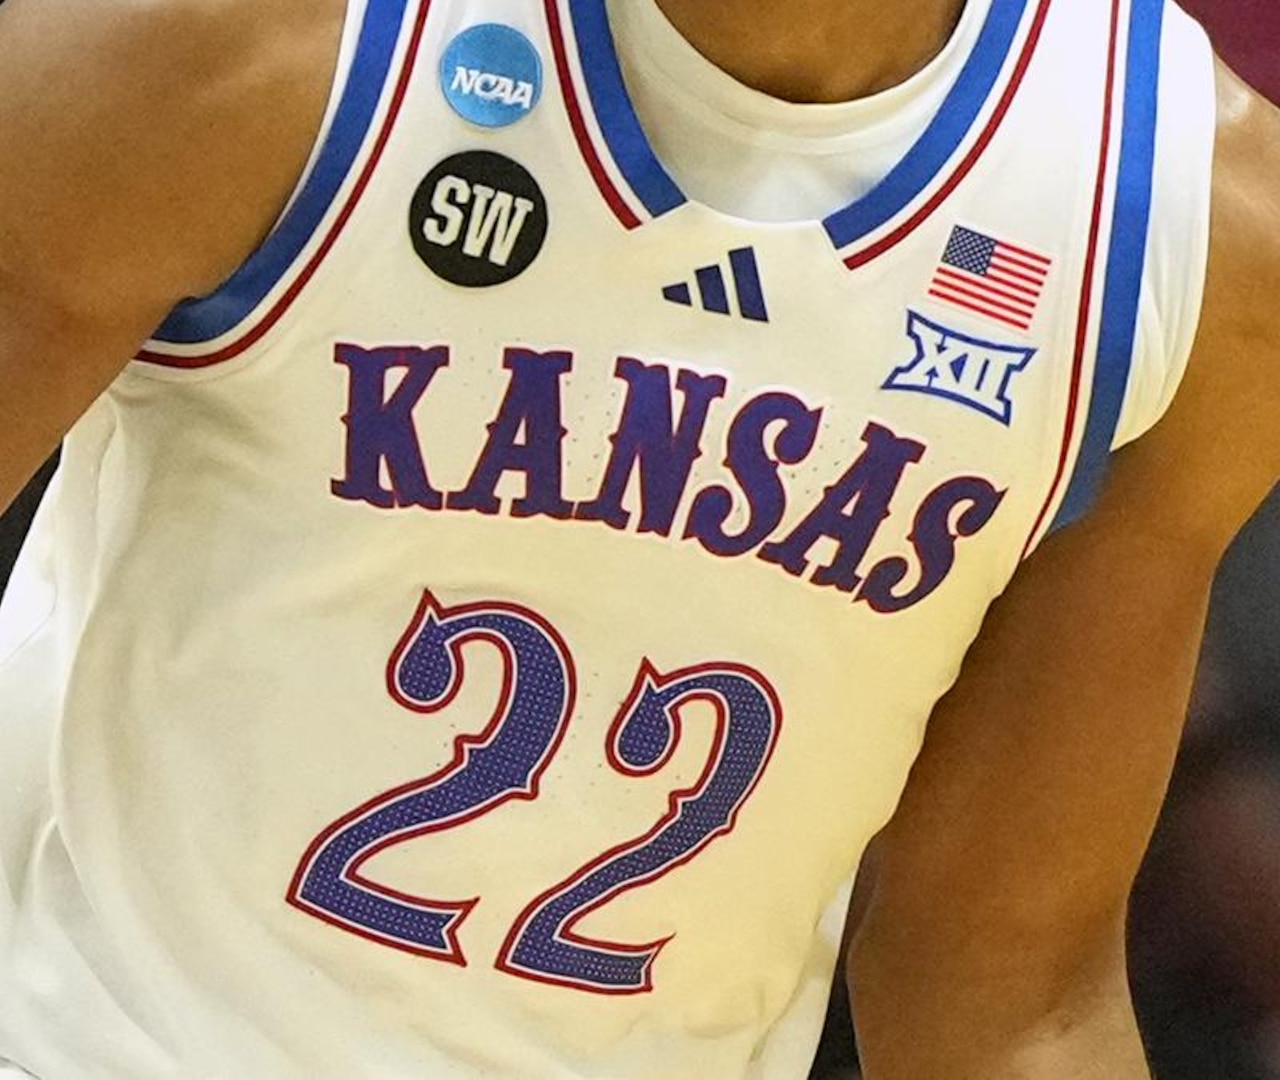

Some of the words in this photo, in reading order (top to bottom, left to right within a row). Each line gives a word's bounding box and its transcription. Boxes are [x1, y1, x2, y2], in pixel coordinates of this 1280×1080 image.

[450, 66, 535, 109] NCAA
[423, 173, 535, 267] SW
[880, 308, 1038, 427] XII
[330, 341, 1008, 614] KANSAS
[285, 587, 784, 995] 22
